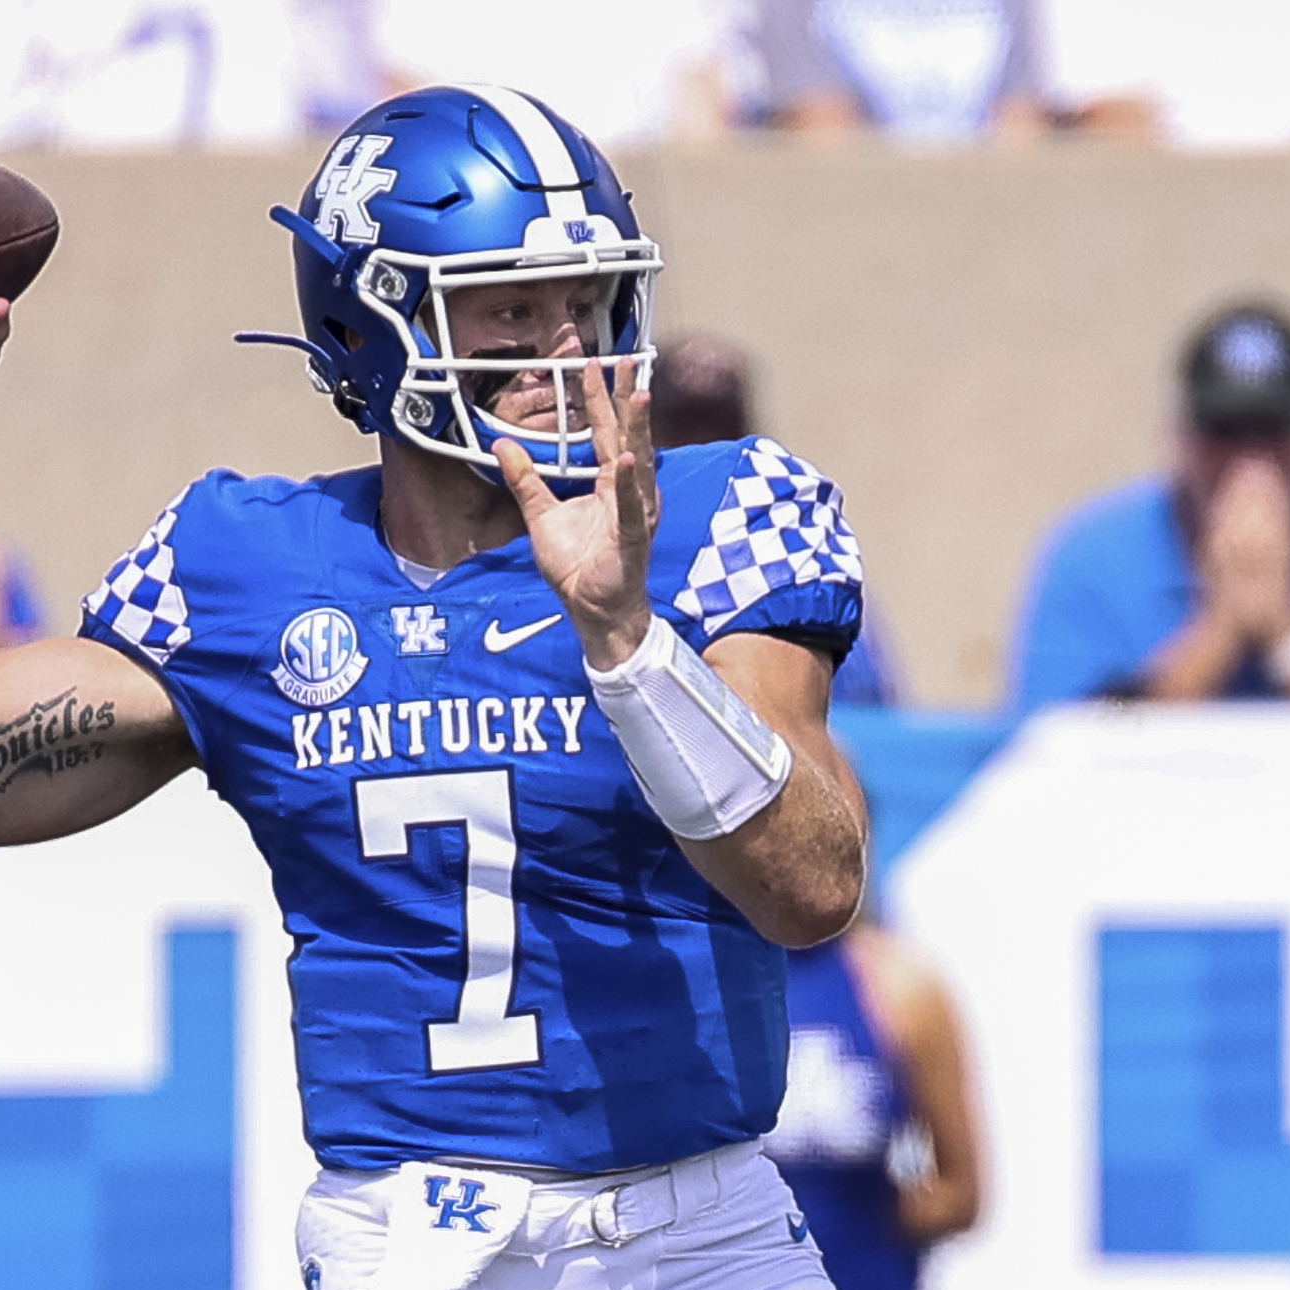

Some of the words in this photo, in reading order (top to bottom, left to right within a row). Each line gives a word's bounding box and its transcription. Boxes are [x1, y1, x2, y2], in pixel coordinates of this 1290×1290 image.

[289, 613, 350, 681] SEC
[391, 605, 449, 655] UK
[283, 671, 356, 706] GRADUATE
[291, 696, 586, 769] KENTUCKY
[353, 766, 541, 1073] 7
[424, 1175, 499, 1233] UK
